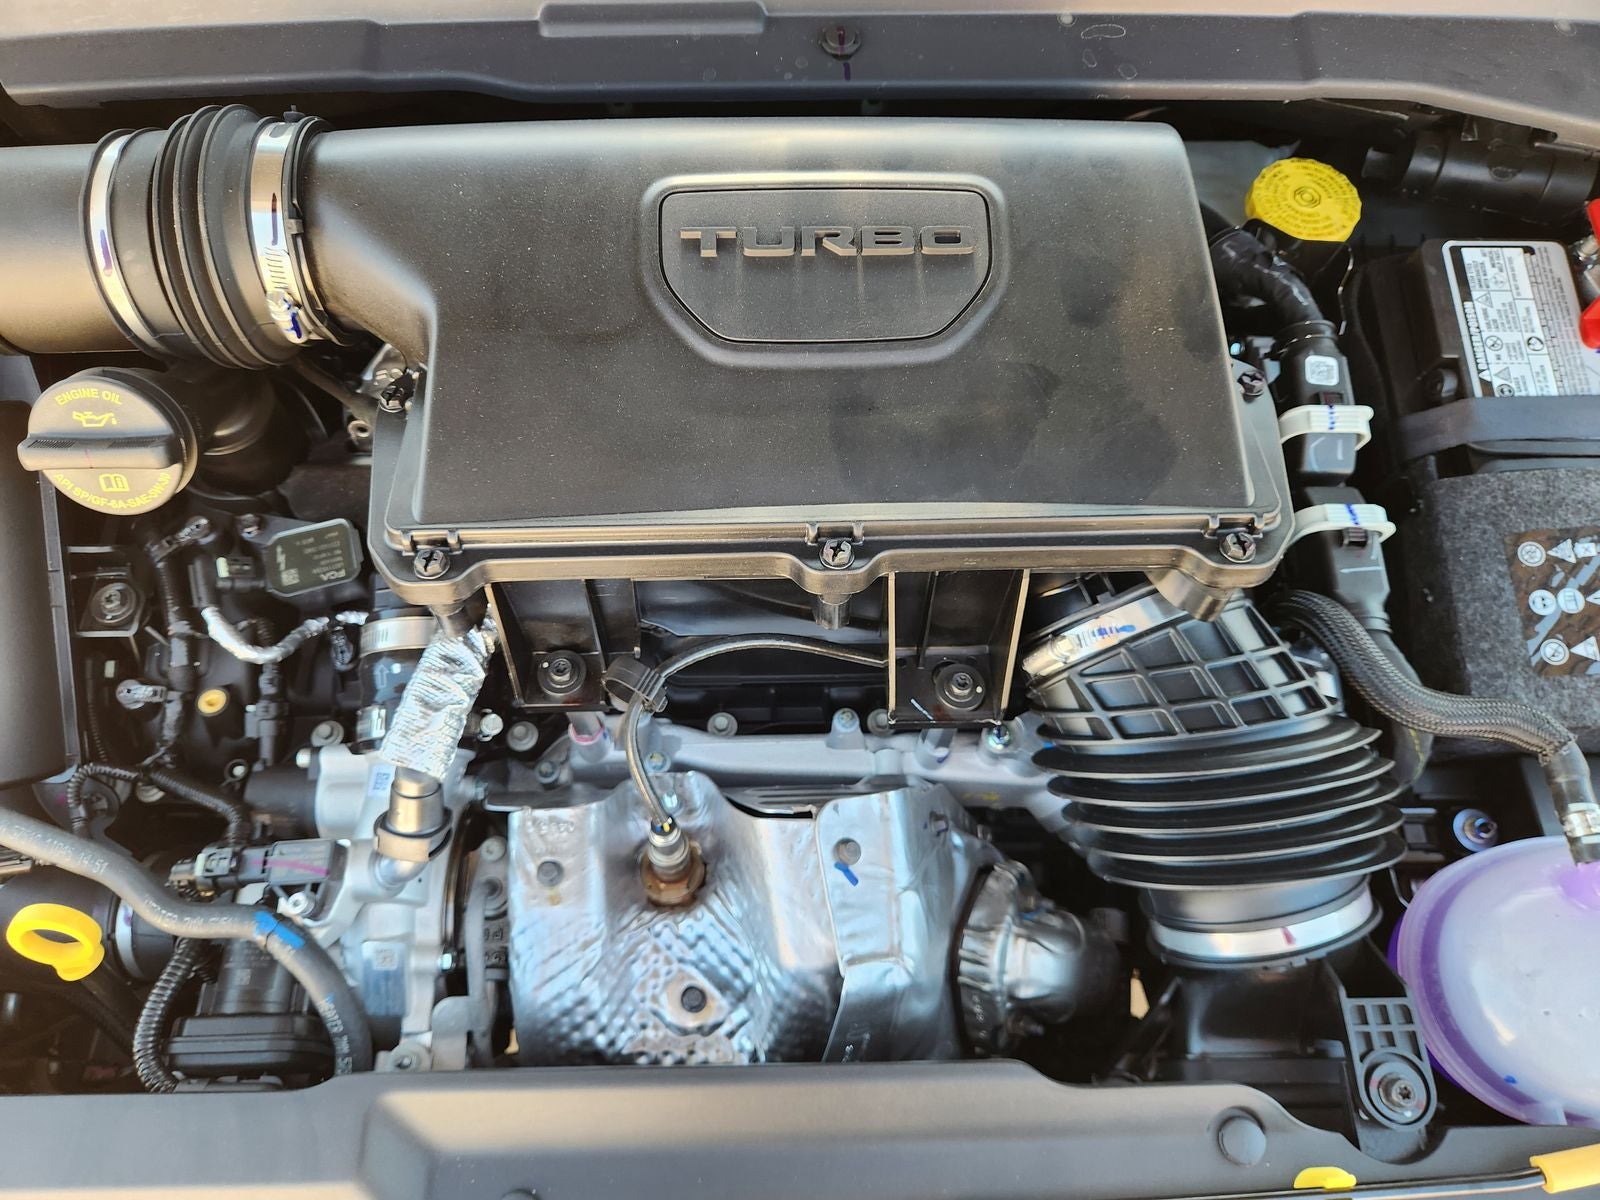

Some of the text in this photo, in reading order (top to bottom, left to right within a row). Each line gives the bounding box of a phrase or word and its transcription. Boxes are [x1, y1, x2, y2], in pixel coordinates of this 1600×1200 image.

[680, 225, 974, 257] TURBO
[55, 387, 122, 405] ENGINE OIL
